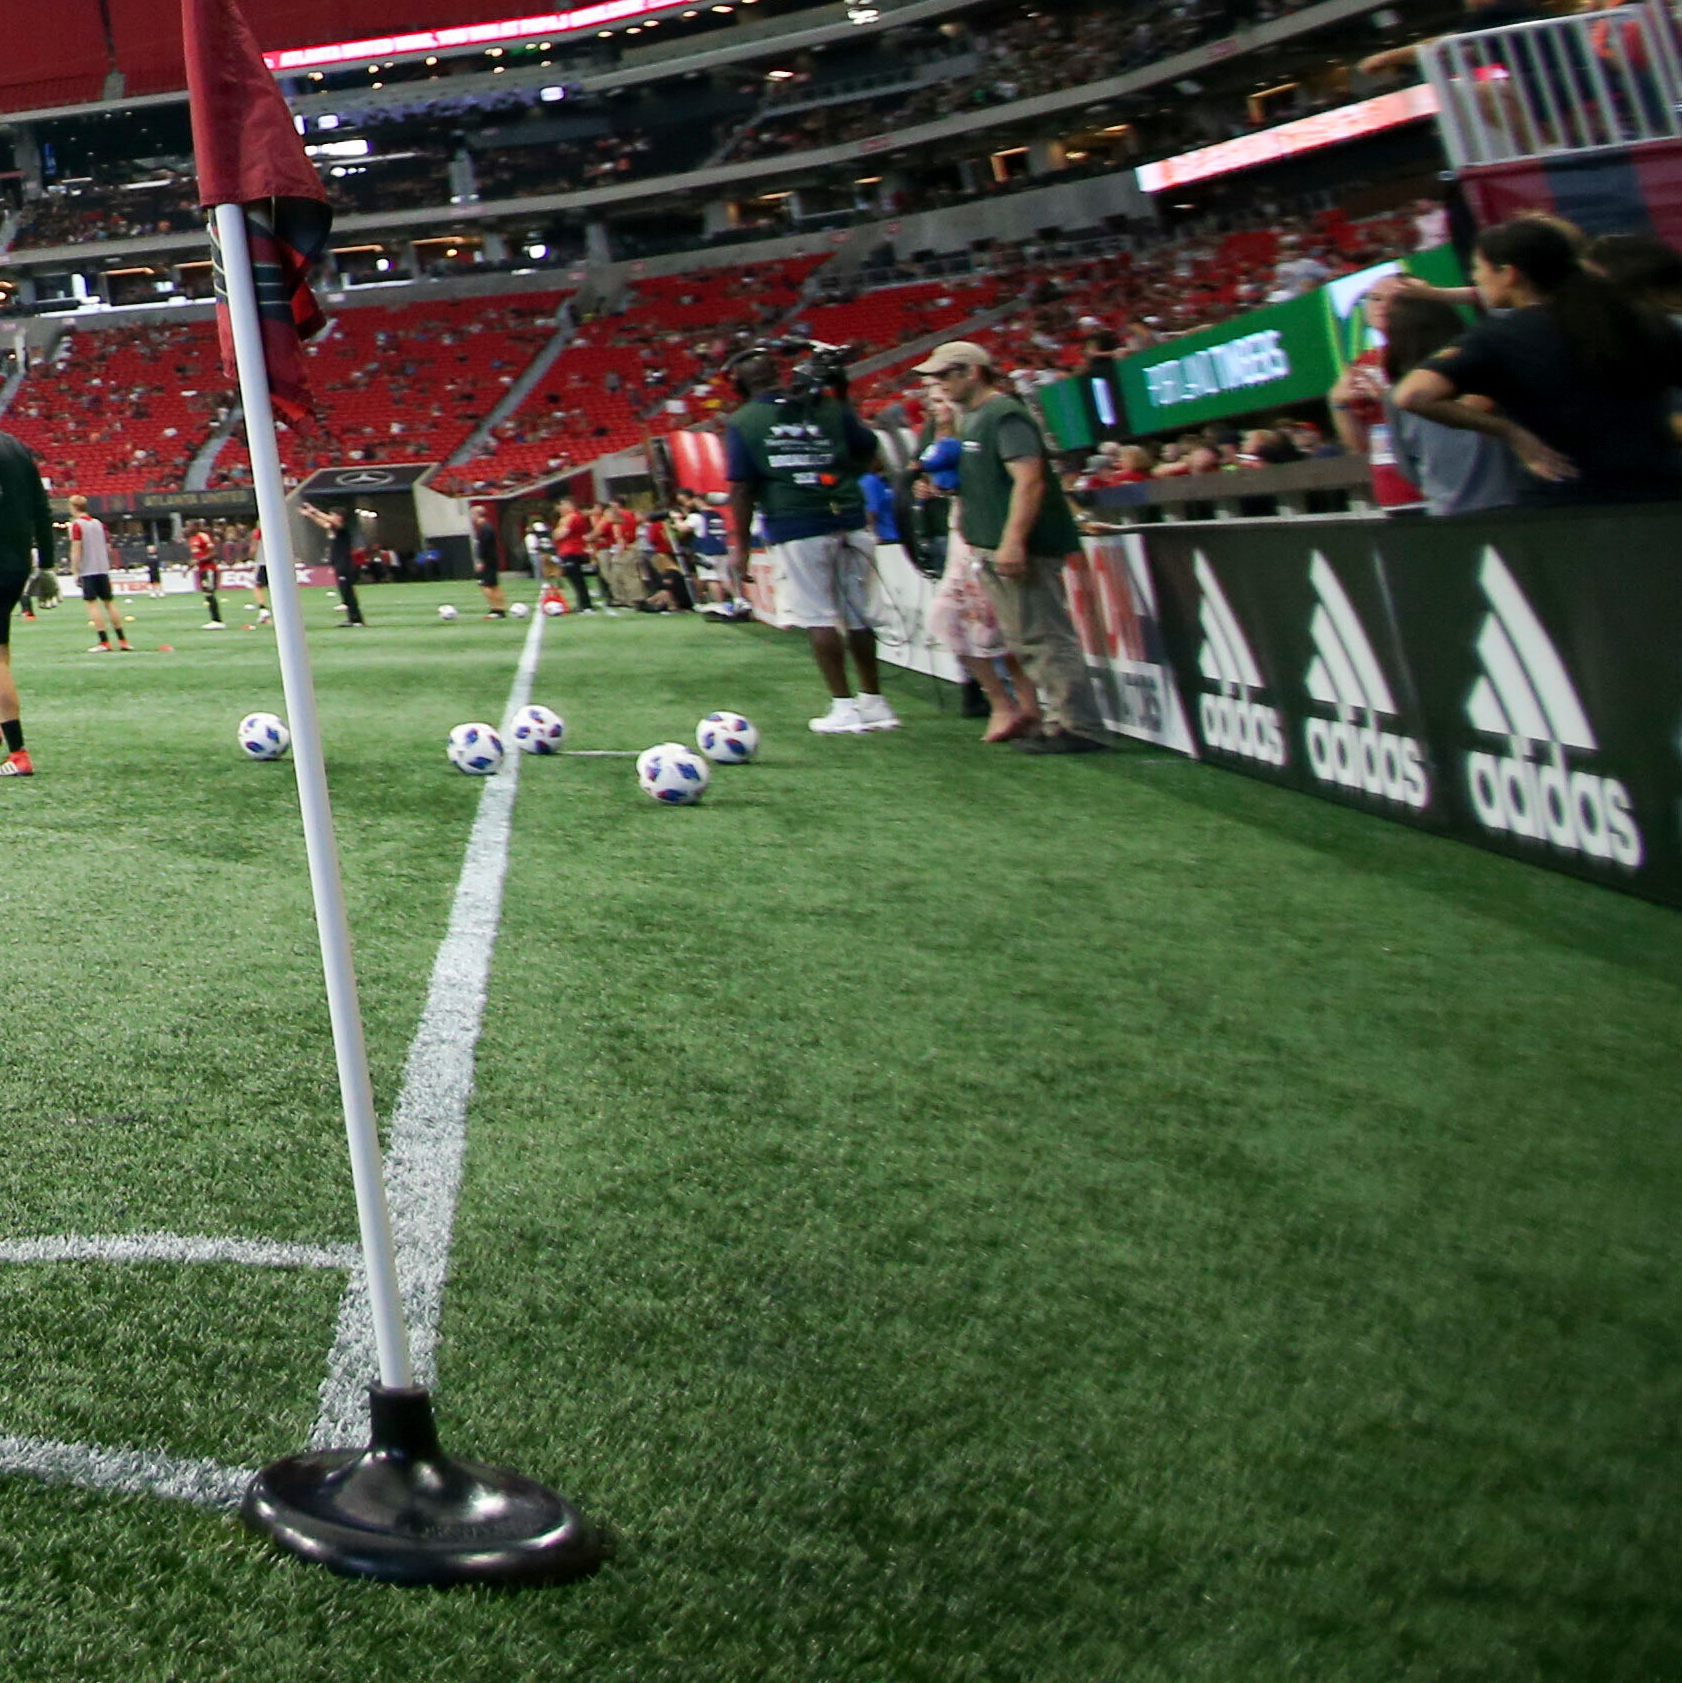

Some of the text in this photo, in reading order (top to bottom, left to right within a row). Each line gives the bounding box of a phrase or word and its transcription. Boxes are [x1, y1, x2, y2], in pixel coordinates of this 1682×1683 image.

[1199, 680, 1286, 766] adidas
[1305, 703, 1430, 809] adidas
[1467, 733, 1643, 867] adidas
